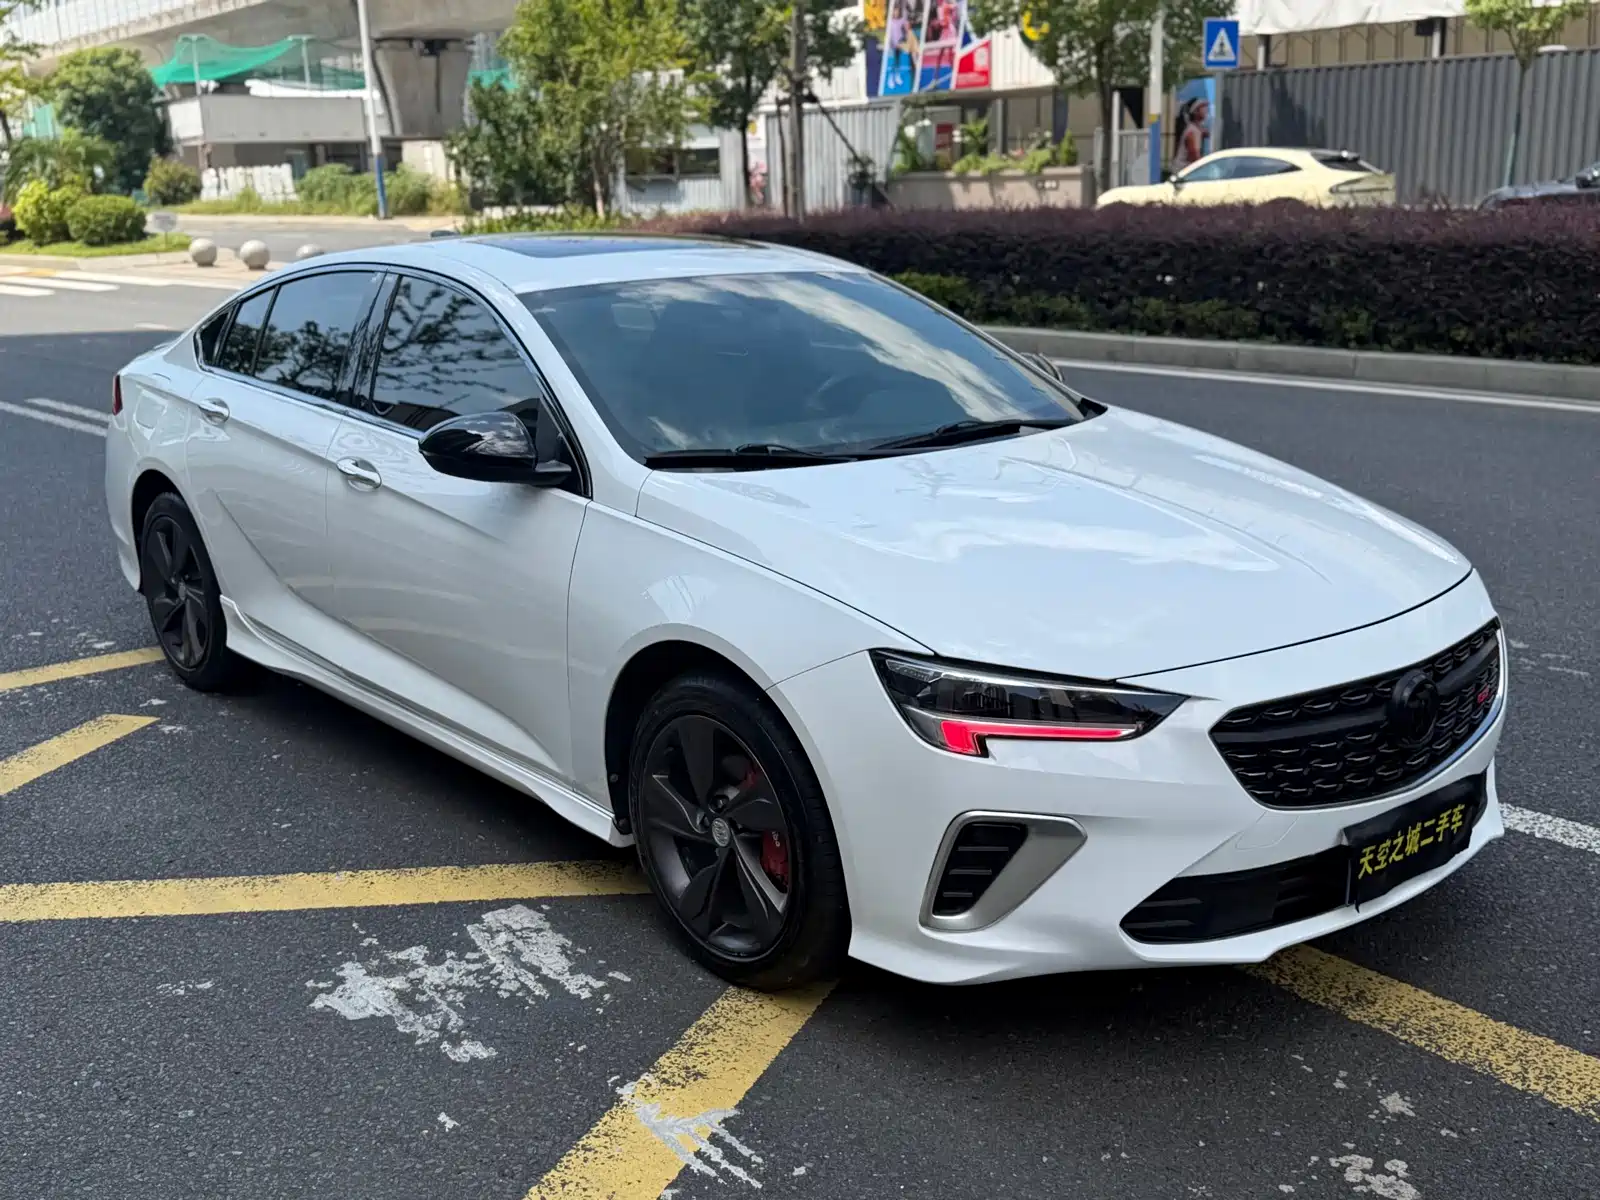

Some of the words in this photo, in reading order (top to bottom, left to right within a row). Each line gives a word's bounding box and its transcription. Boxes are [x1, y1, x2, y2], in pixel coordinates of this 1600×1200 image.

[1358, 804, 1465, 879] 天空之城二手车
